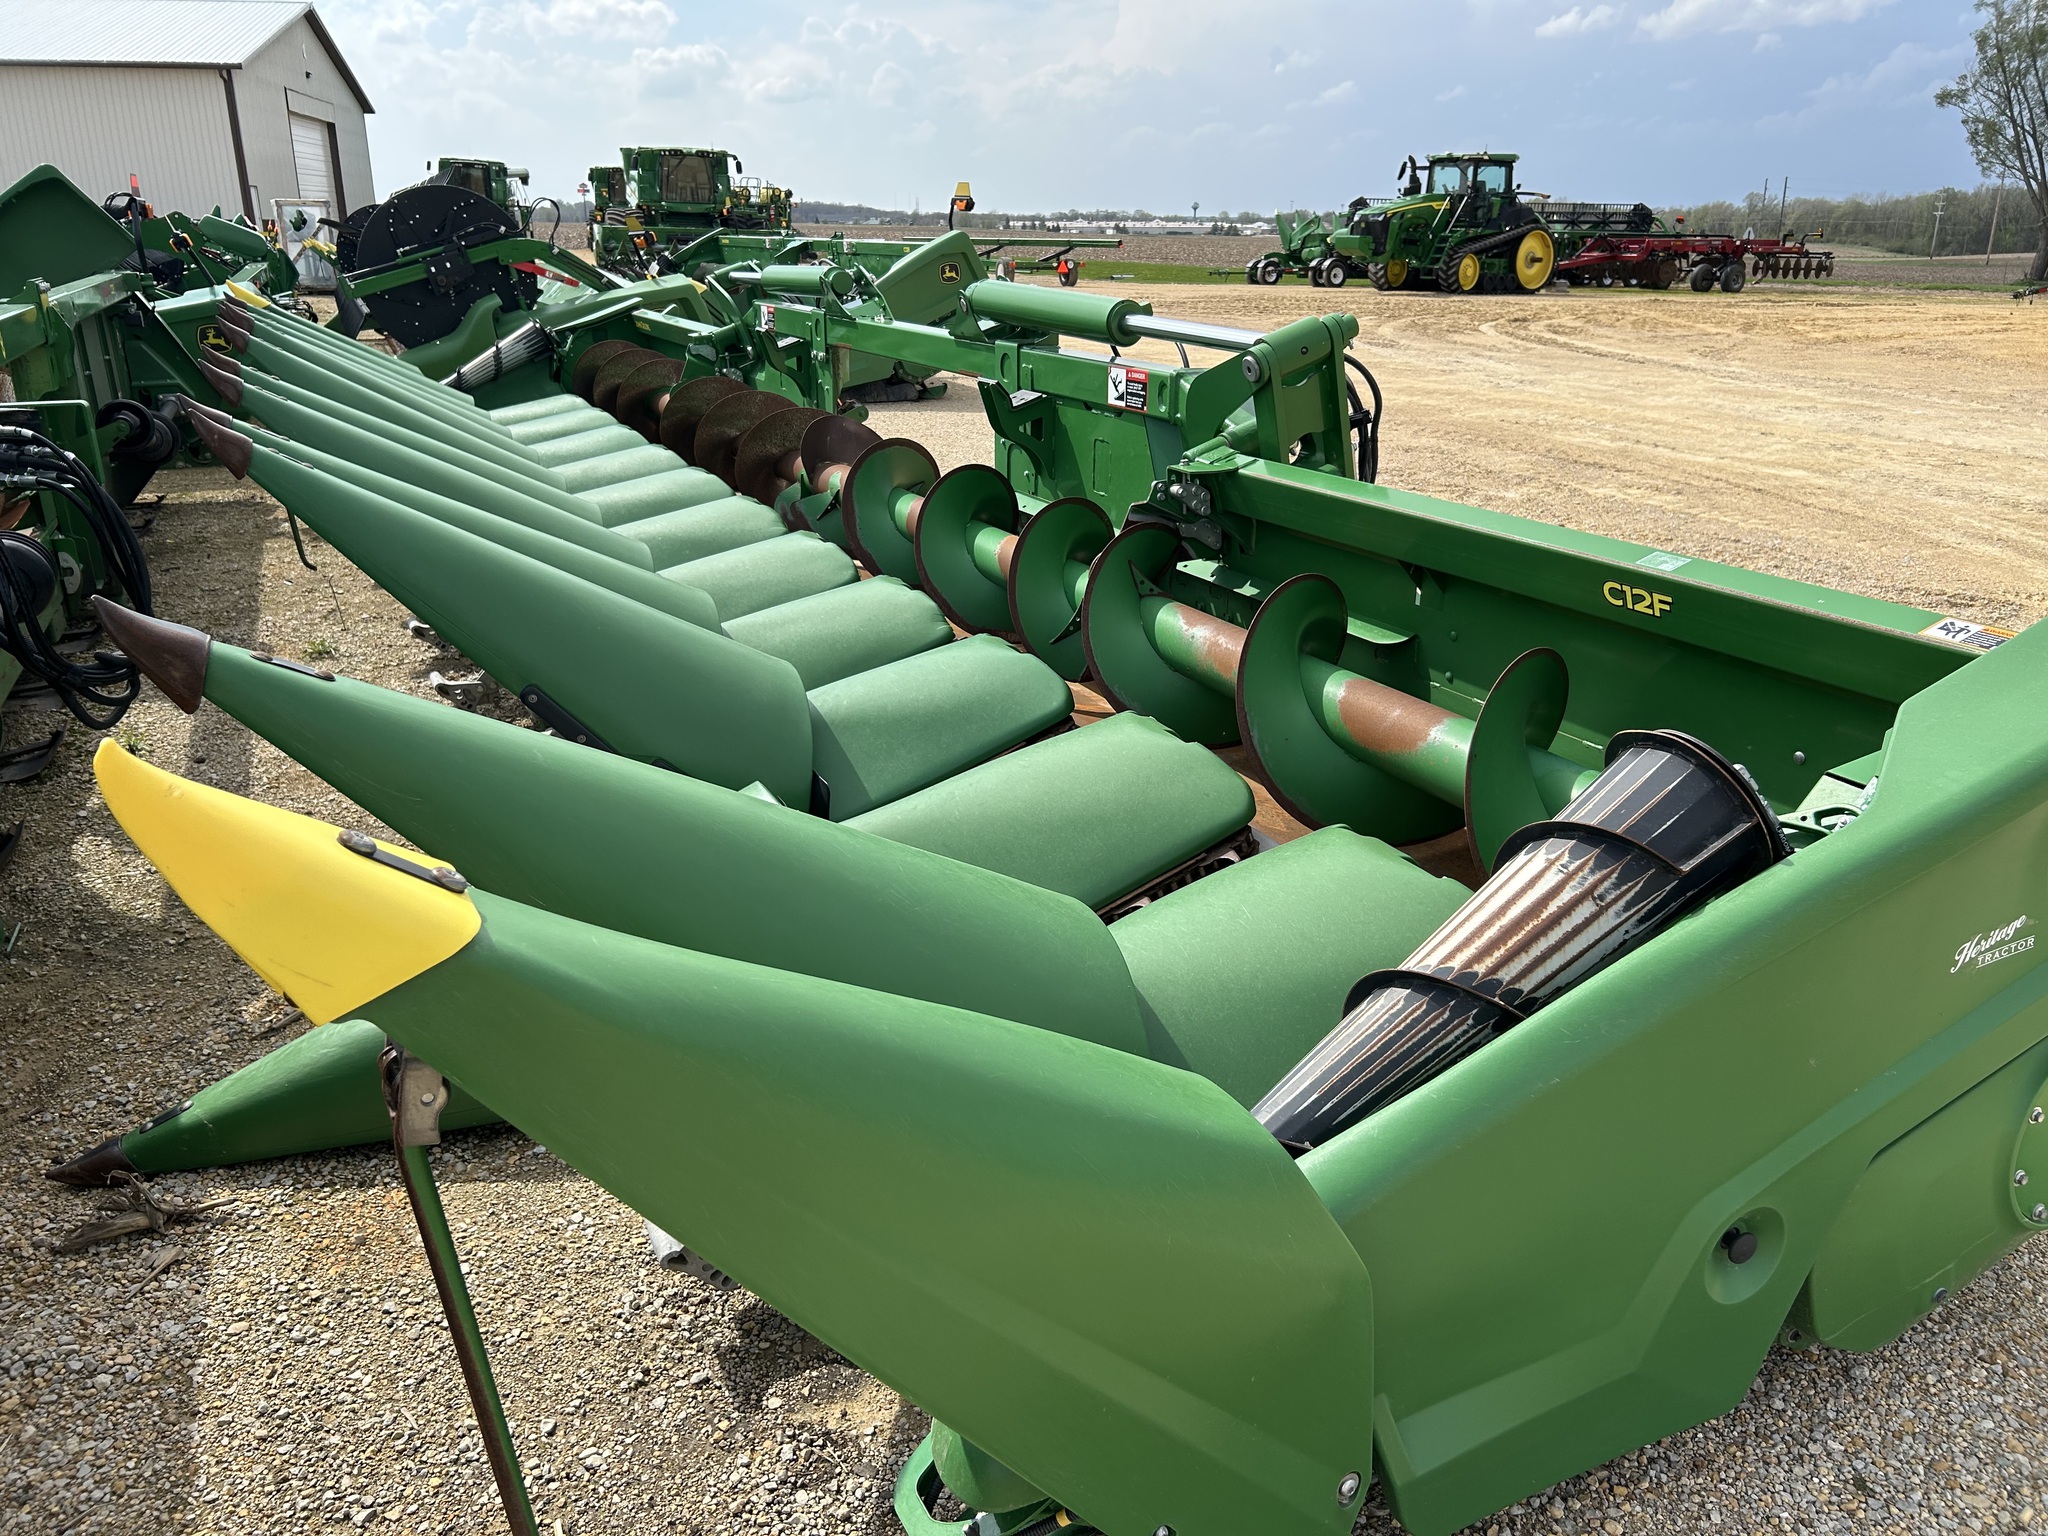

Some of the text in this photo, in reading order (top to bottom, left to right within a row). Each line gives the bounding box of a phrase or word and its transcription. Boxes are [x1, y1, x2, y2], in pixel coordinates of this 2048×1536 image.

[1603, 581, 1673, 617] C12F
[1950, 914, 2026, 973] Heritage
[1977, 937, 2035, 965] TRACTOR
